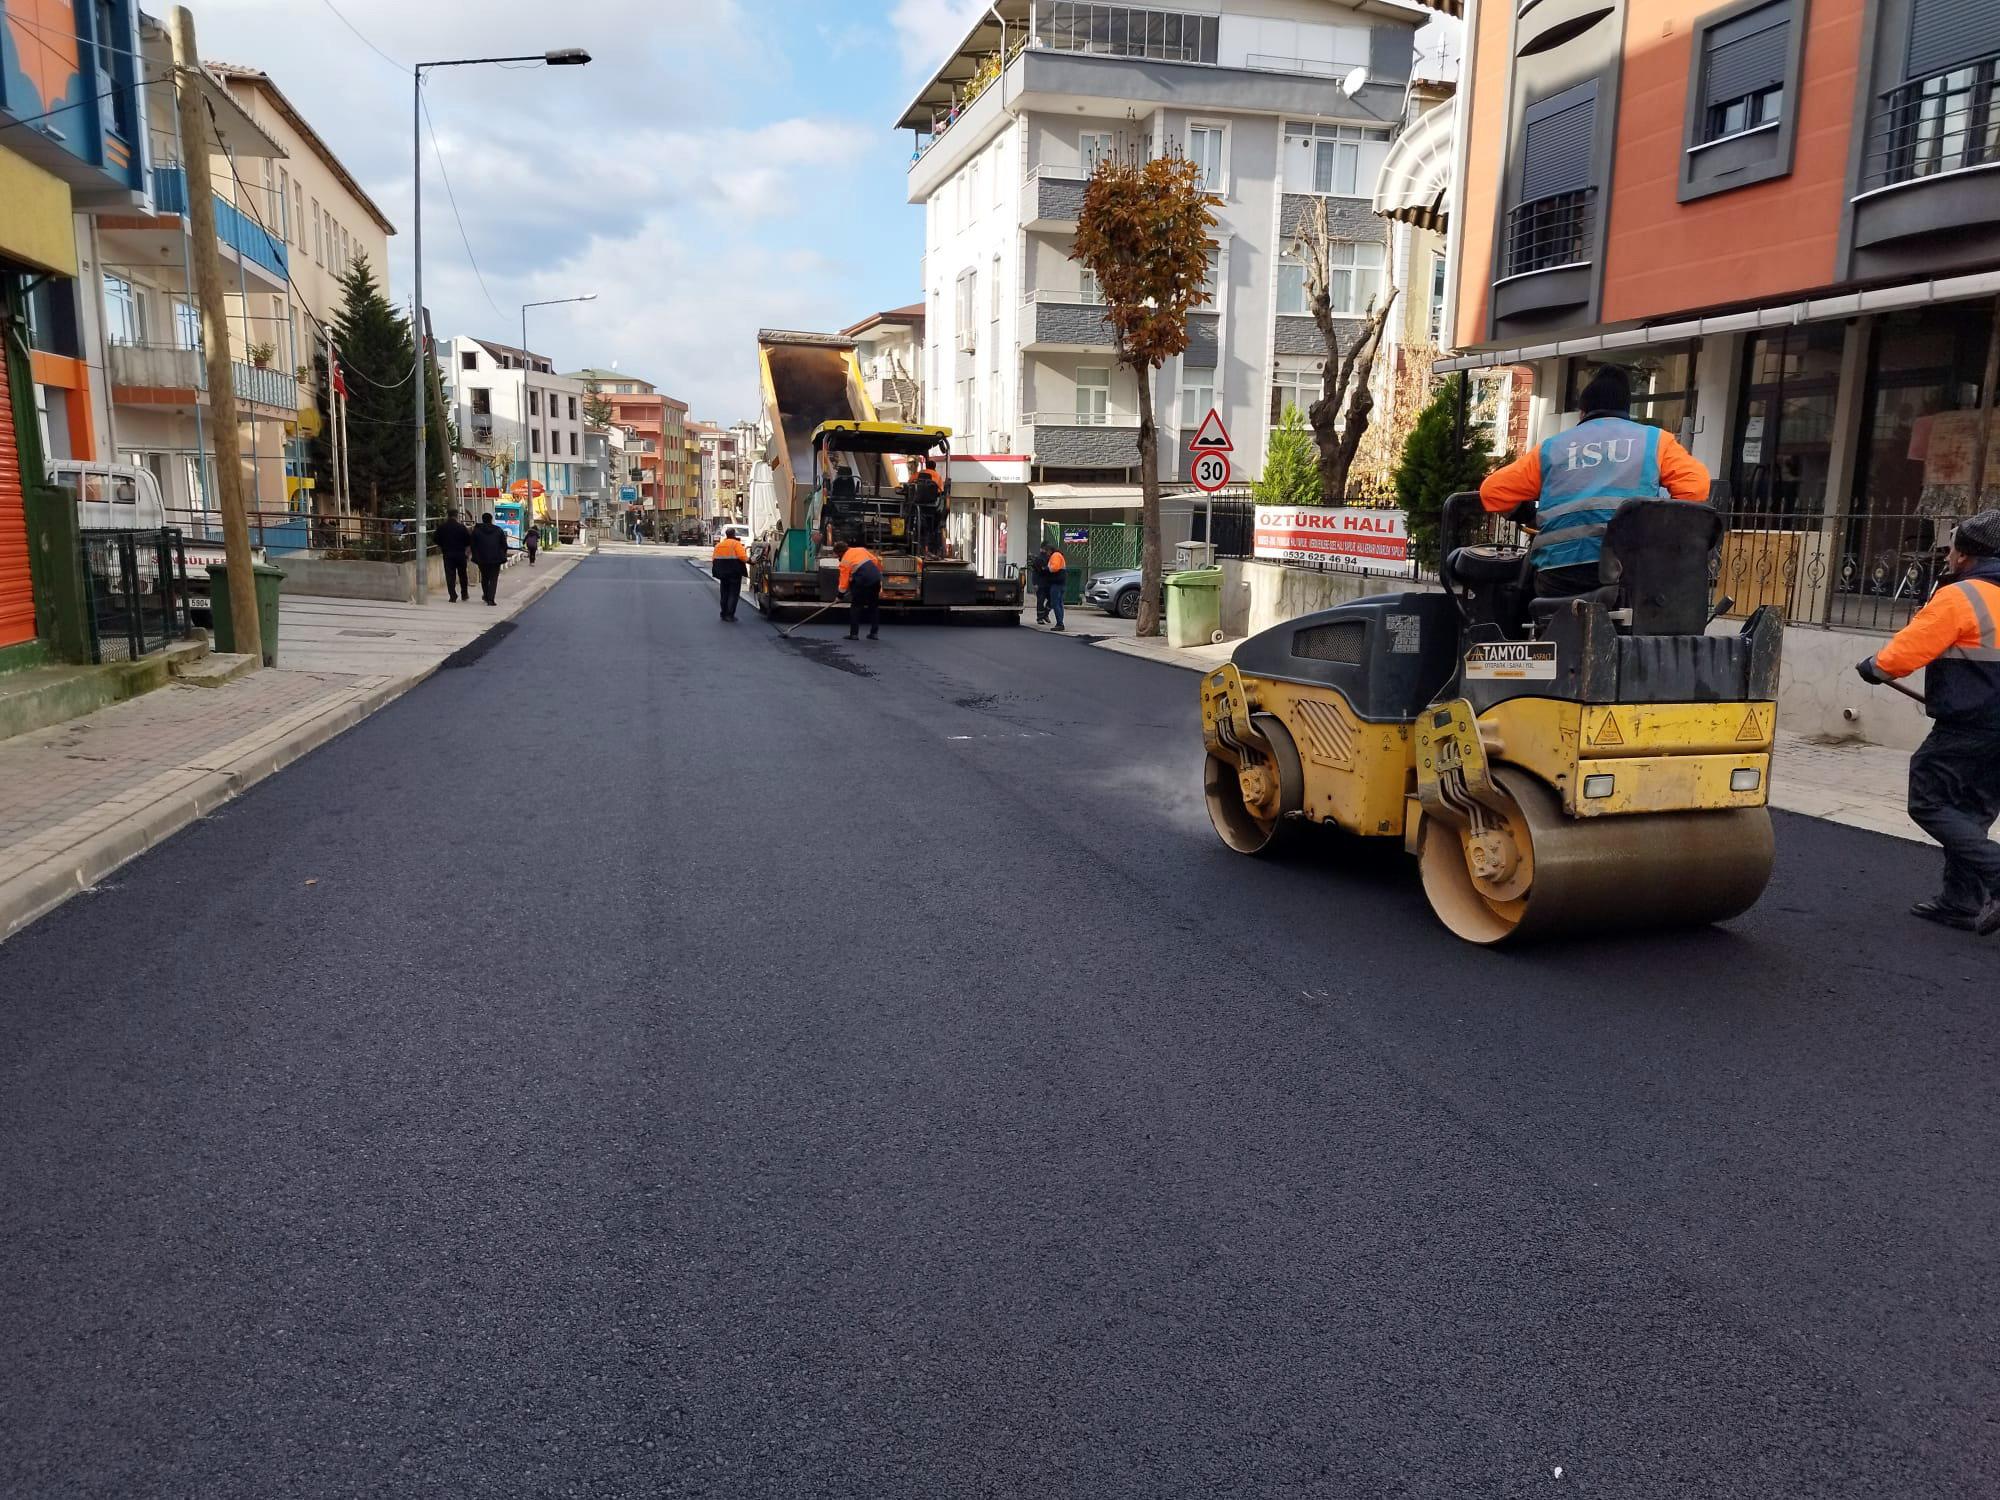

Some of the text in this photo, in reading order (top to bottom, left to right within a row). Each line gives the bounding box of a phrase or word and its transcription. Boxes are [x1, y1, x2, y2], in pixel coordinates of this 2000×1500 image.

[1200, 461, 1223, 481] 30
[1260, 511, 1395, 533] ÖZTÜRK HALI
[1283, 551, 1357, 565] 0532 625 46 94
[1483, 645, 1533, 661] TAMYOL
